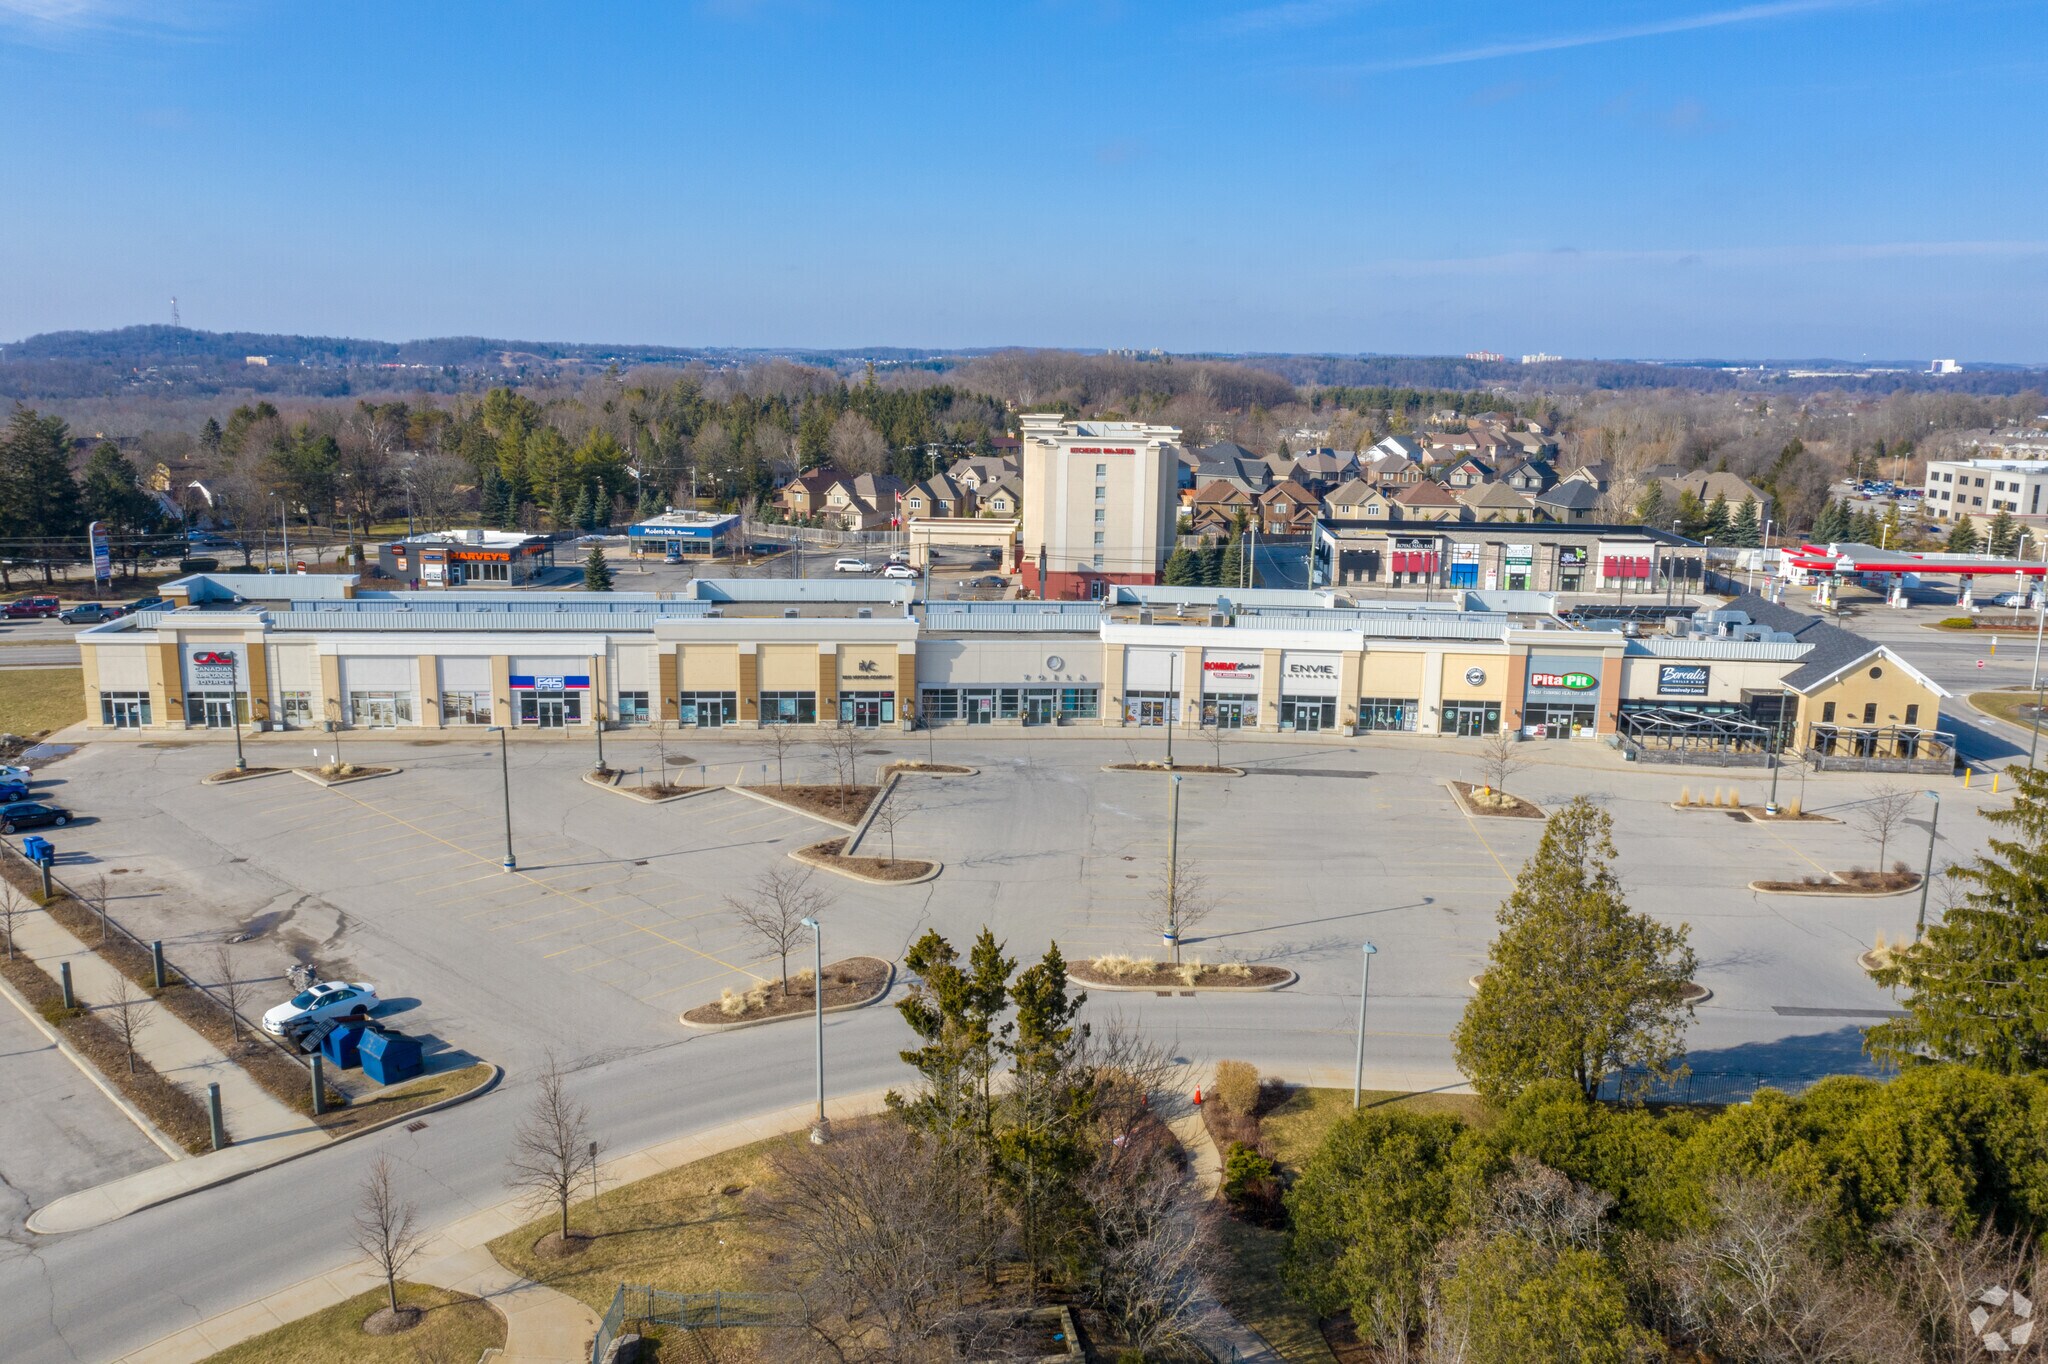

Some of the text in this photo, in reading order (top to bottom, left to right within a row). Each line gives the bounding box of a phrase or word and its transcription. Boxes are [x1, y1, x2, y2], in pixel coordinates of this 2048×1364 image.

[451, 552, 510, 561] HARVEY'S
[1204, 662, 1237, 670] BOMBAY
[1290, 664, 1334, 674] ENVIE
[1662, 667, 1706, 681] Borealis
[537, 677, 564, 689] F45
[1532, 674, 1588, 686] Pita Pit
[636, 714, 649, 722] SALE
